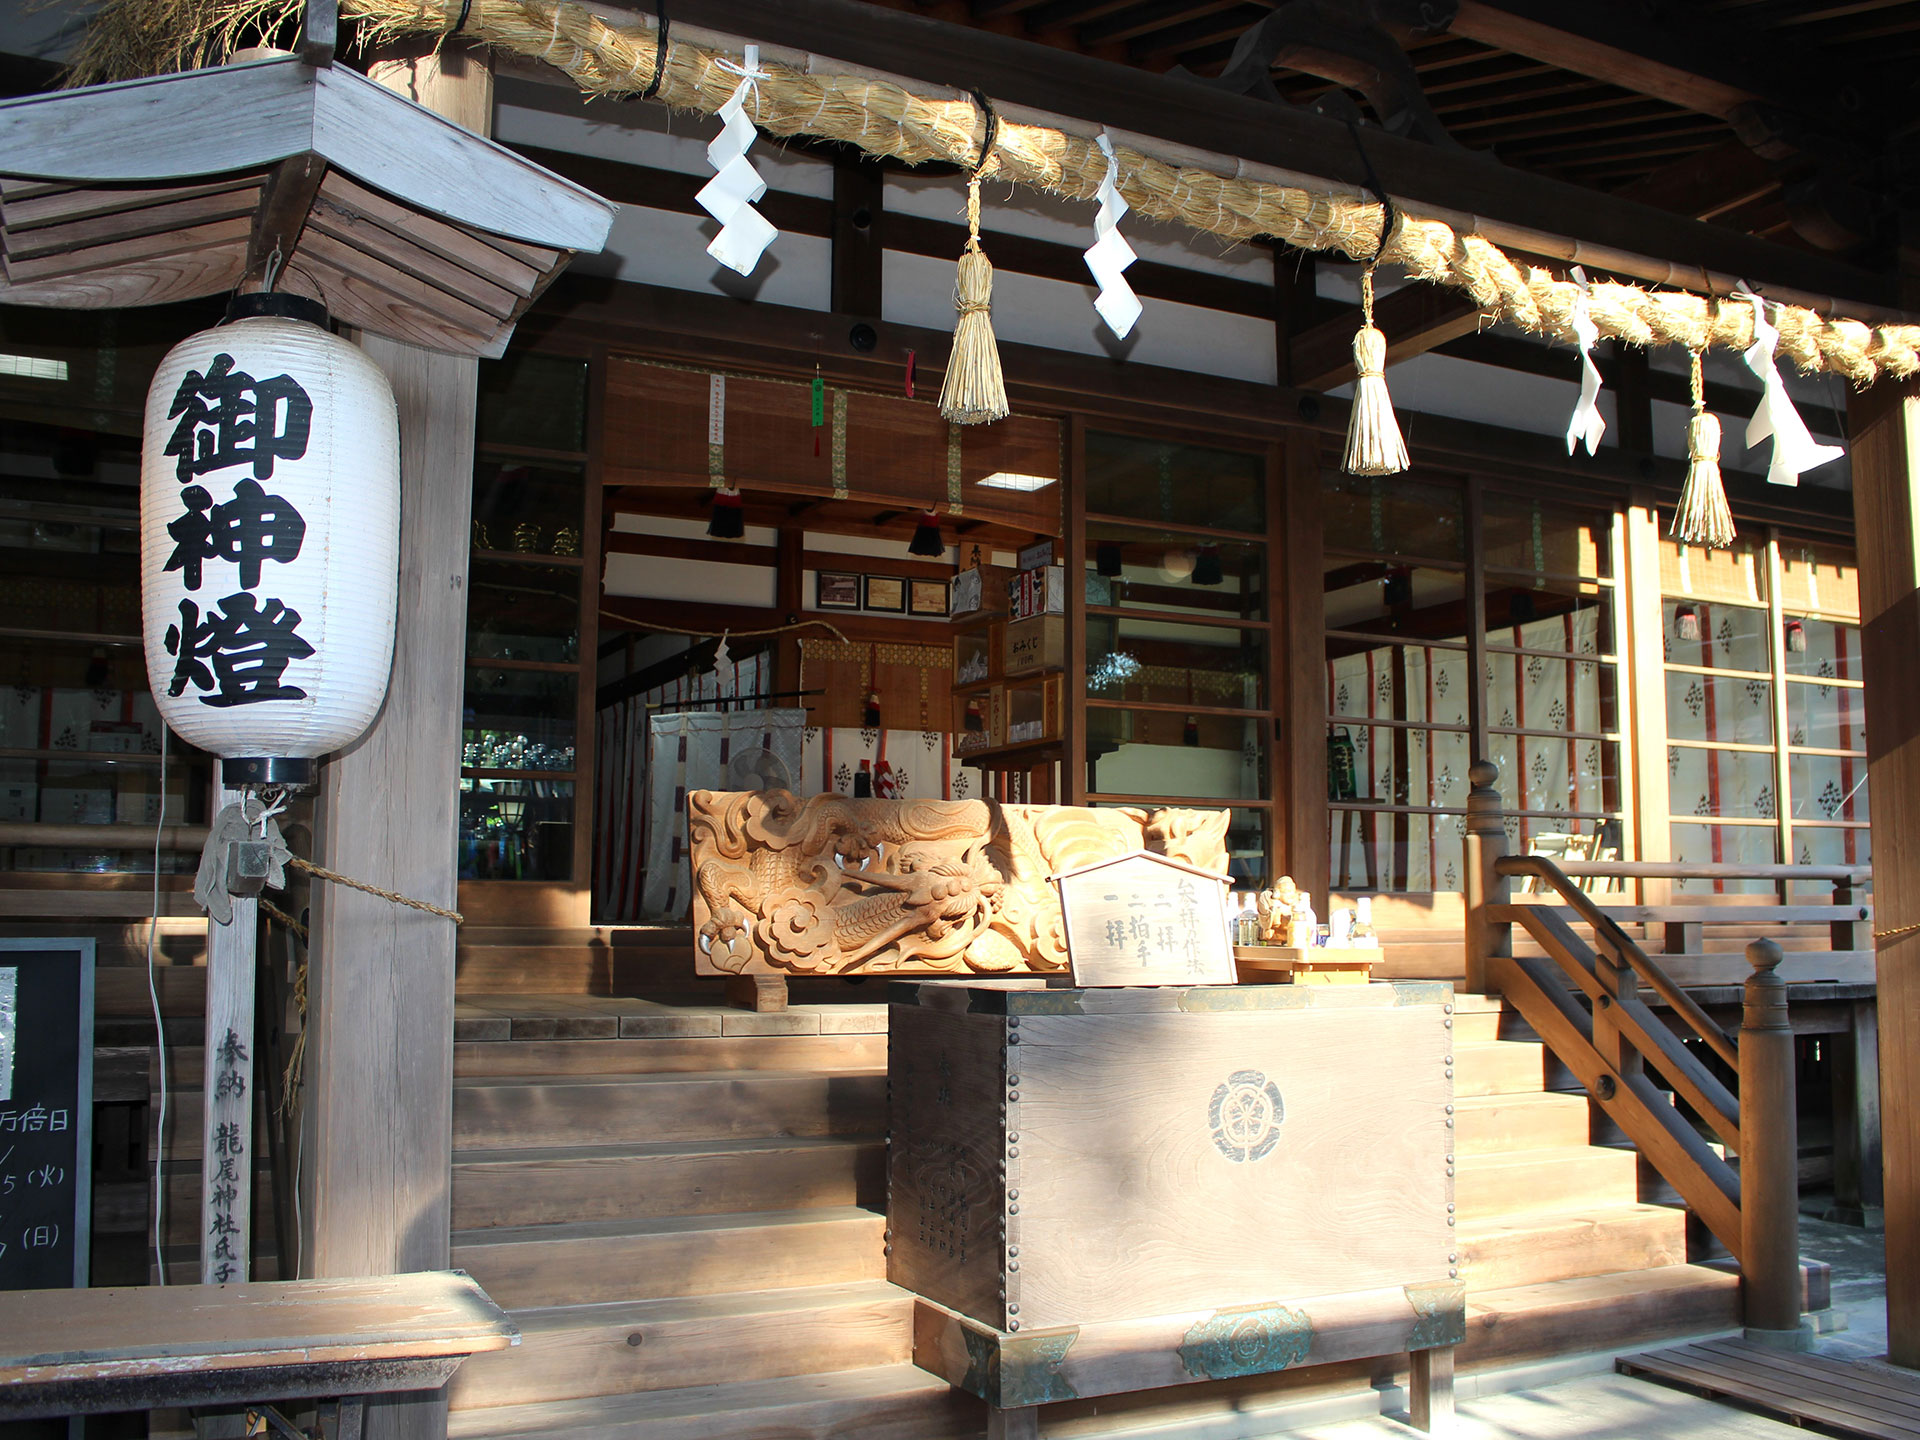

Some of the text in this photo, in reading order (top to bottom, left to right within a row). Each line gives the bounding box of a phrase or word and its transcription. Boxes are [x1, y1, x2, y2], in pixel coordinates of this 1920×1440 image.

[163, 353, 316, 708] 御神燈
[1012, 636, 1039, 654] おみくじ
[214, 1027, 249, 1101] 奉納
